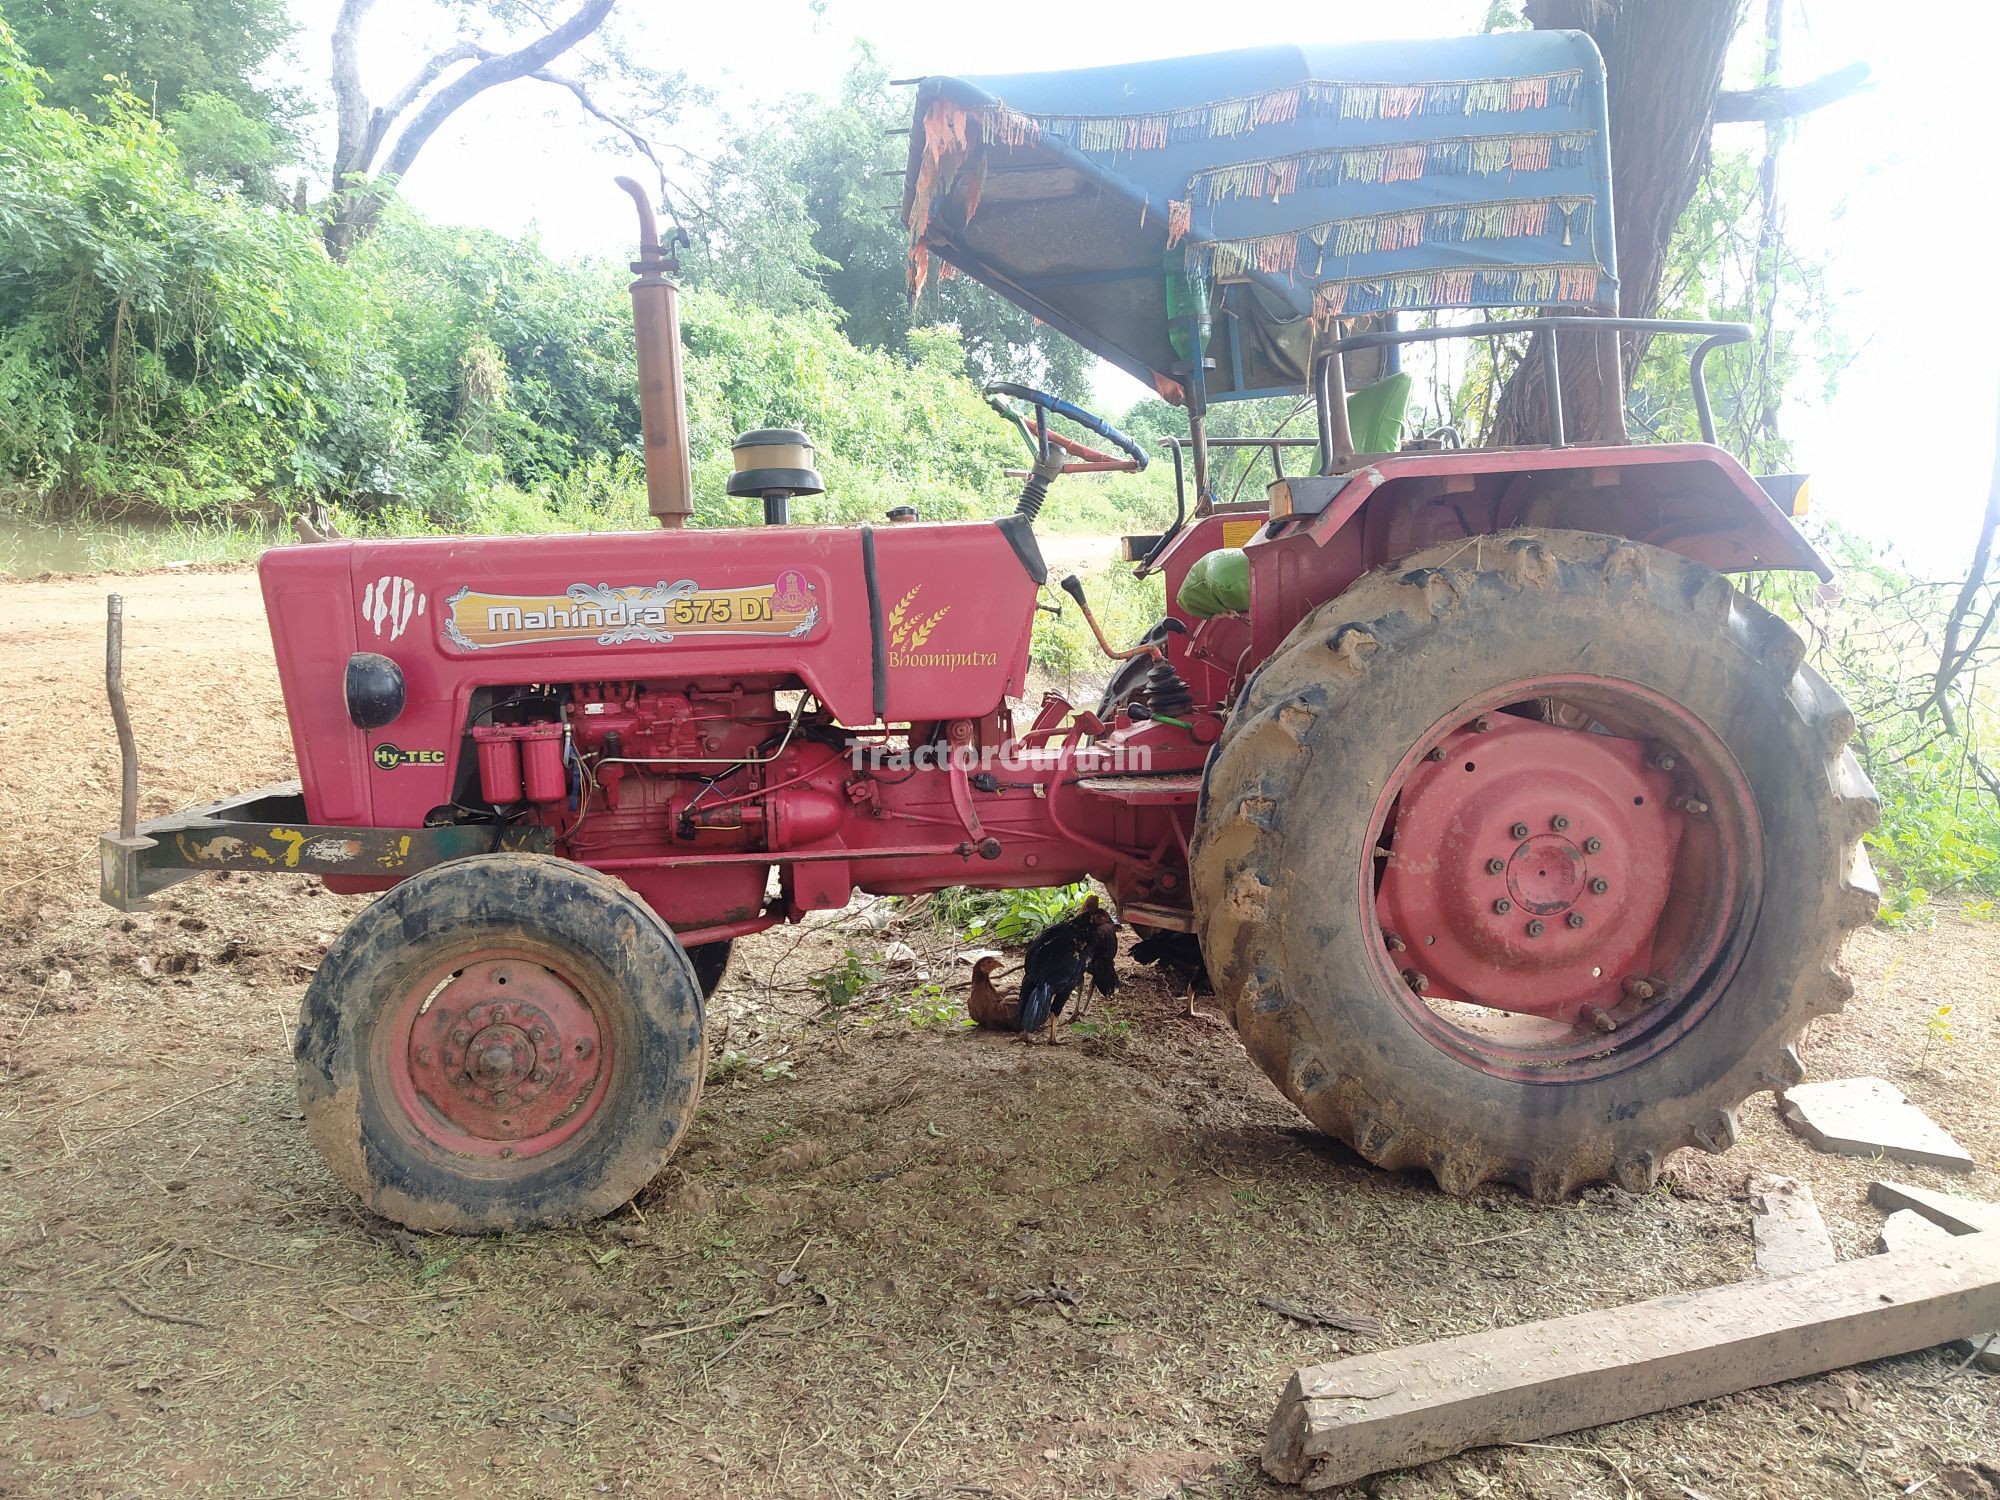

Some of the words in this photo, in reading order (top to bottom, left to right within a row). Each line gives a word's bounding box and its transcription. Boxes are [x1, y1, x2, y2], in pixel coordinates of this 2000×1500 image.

[487, 605, 666, 630] Mahindra
[674, 600, 731, 624] 575
[740, 598, 771, 621] DI
[888, 649, 997, 672] Bhoomiputra
[374, 751, 444, 765] Hy-TEC
